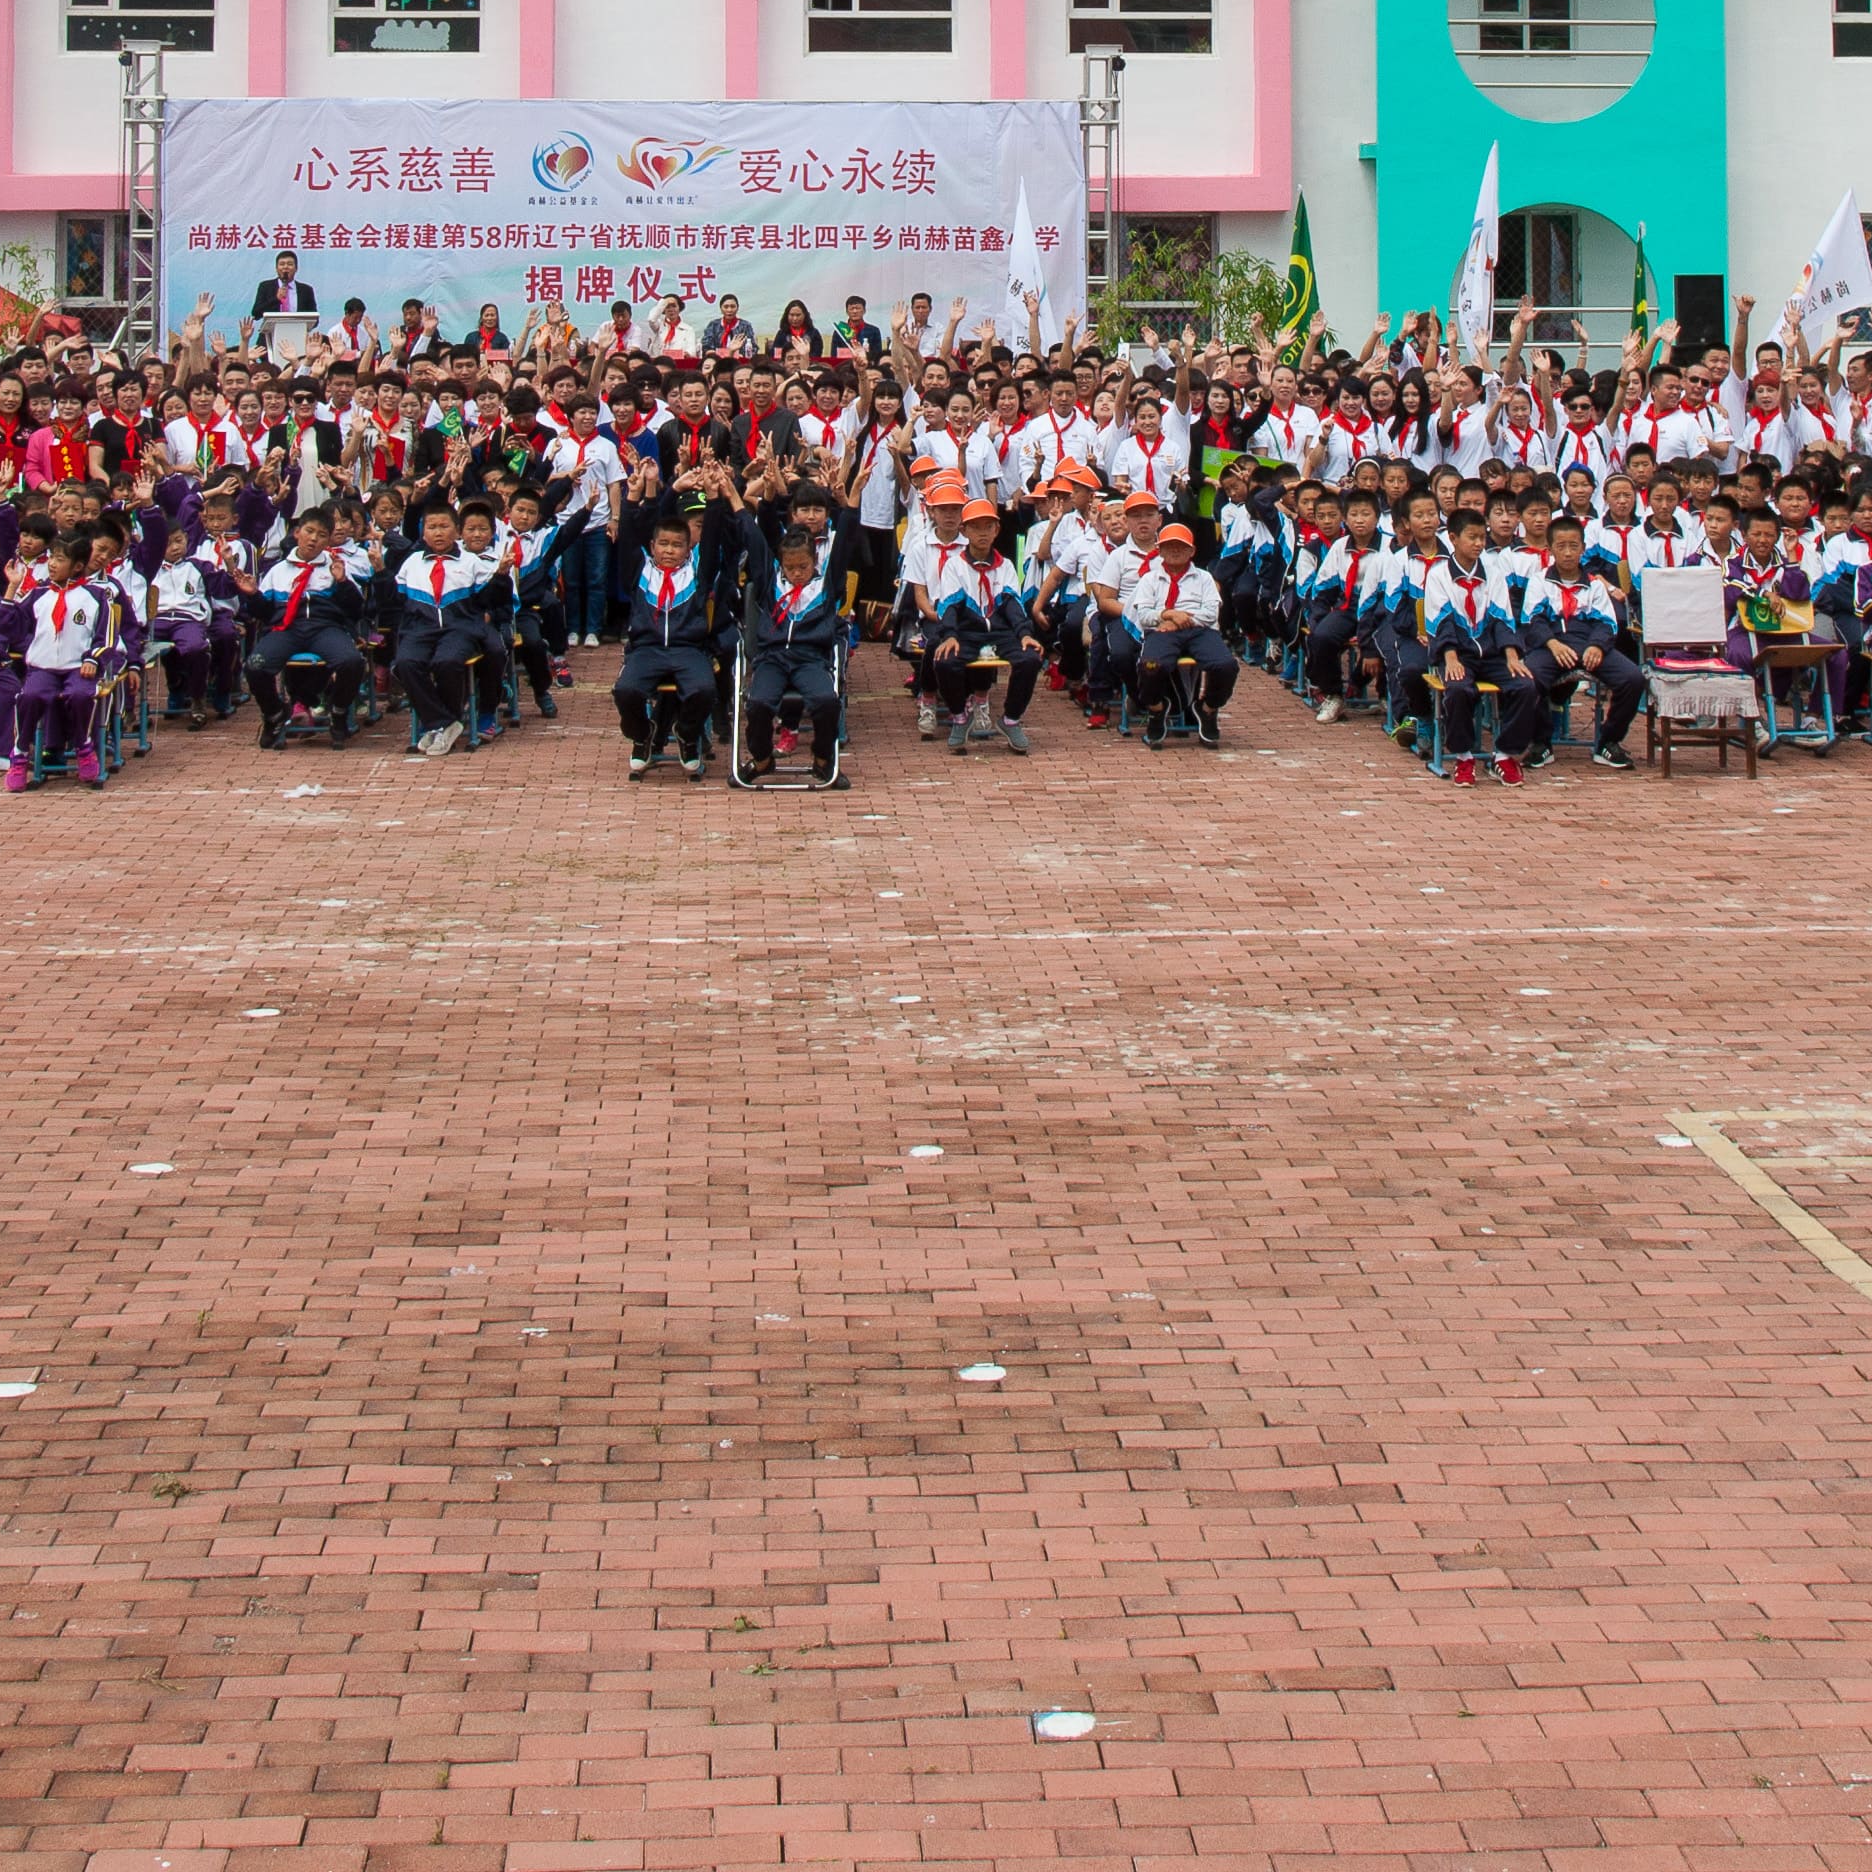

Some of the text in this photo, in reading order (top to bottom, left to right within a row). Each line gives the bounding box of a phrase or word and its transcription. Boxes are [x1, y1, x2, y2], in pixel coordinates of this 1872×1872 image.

[294, 146, 497, 193] 心系慈善
[739, 148, 937, 196] 爱心永续
[188, 223, 1060, 251] 尚赫公益基金会援建第58所辽宁省抚顺市新宾县北四平乡尚赫苗鑫学
[525, 265, 716, 304] 揭牌仪式
